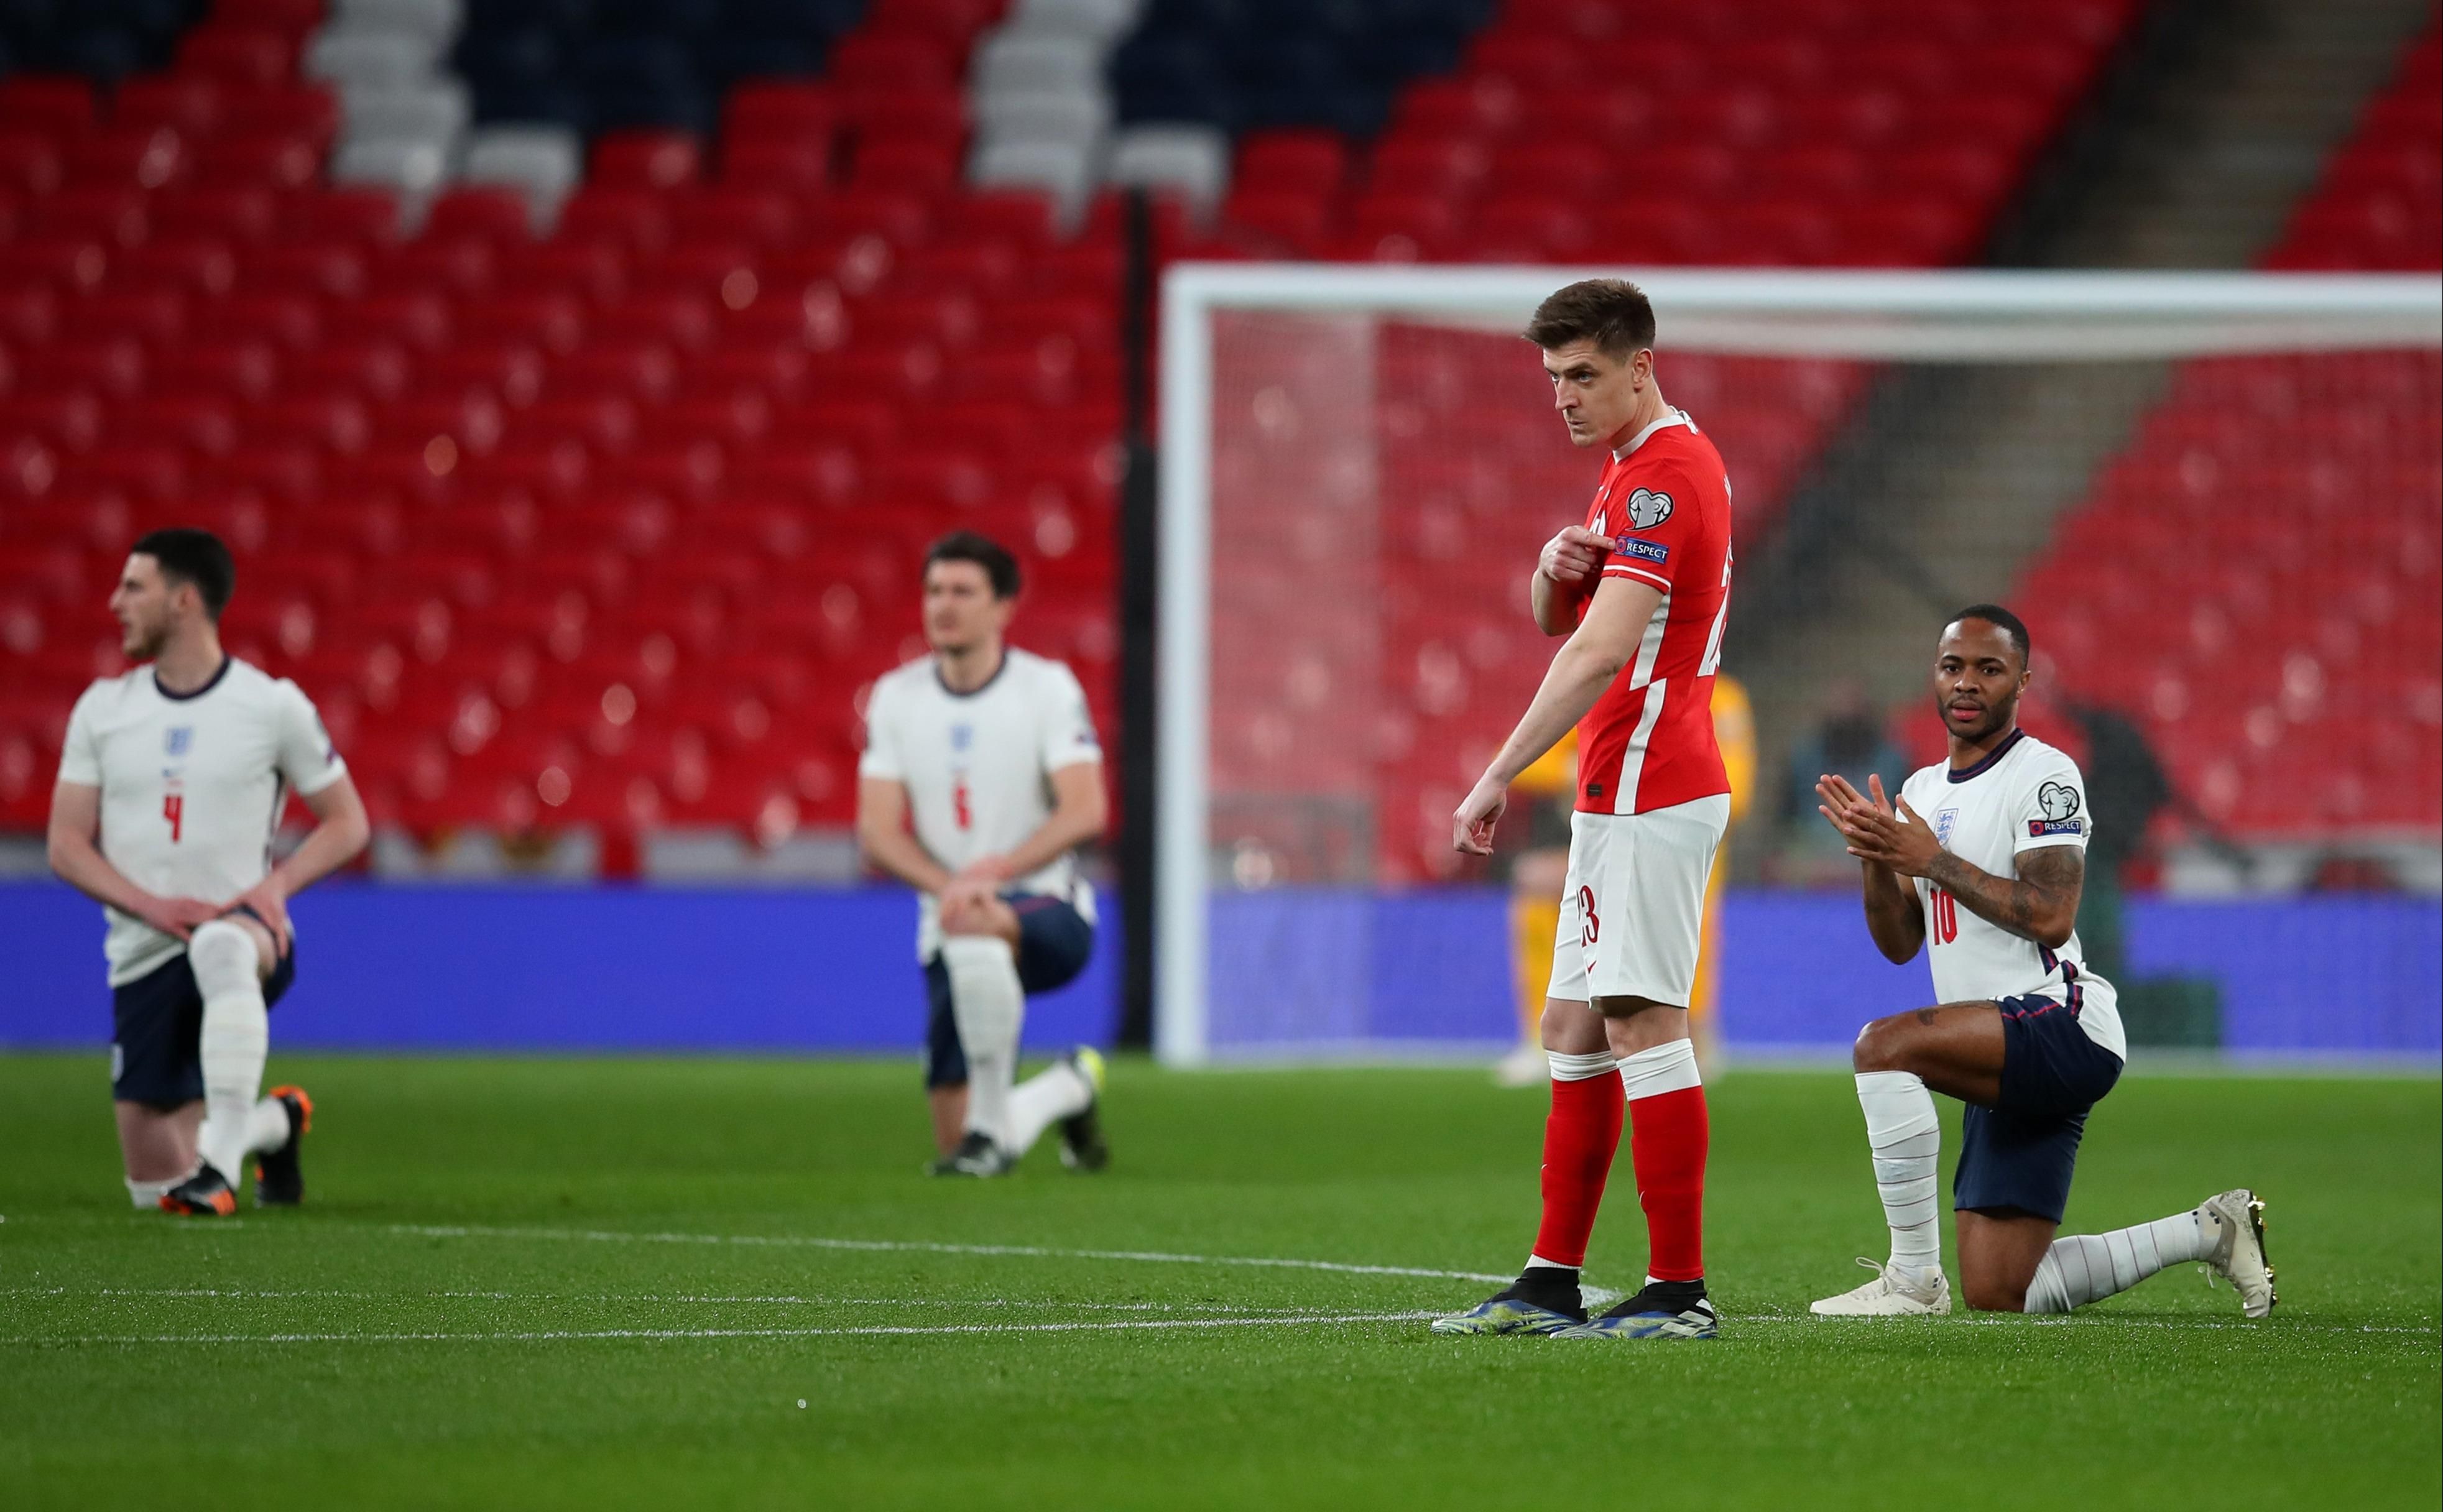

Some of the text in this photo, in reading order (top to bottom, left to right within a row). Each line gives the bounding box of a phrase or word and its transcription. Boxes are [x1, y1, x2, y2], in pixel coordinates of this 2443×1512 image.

[1627, 542, 1668, 559] RESPECT
[163, 793, 183, 845] 4
[2044, 821, 2080, 831] RESPECT
[1930, 888, 1957, 946] 10
